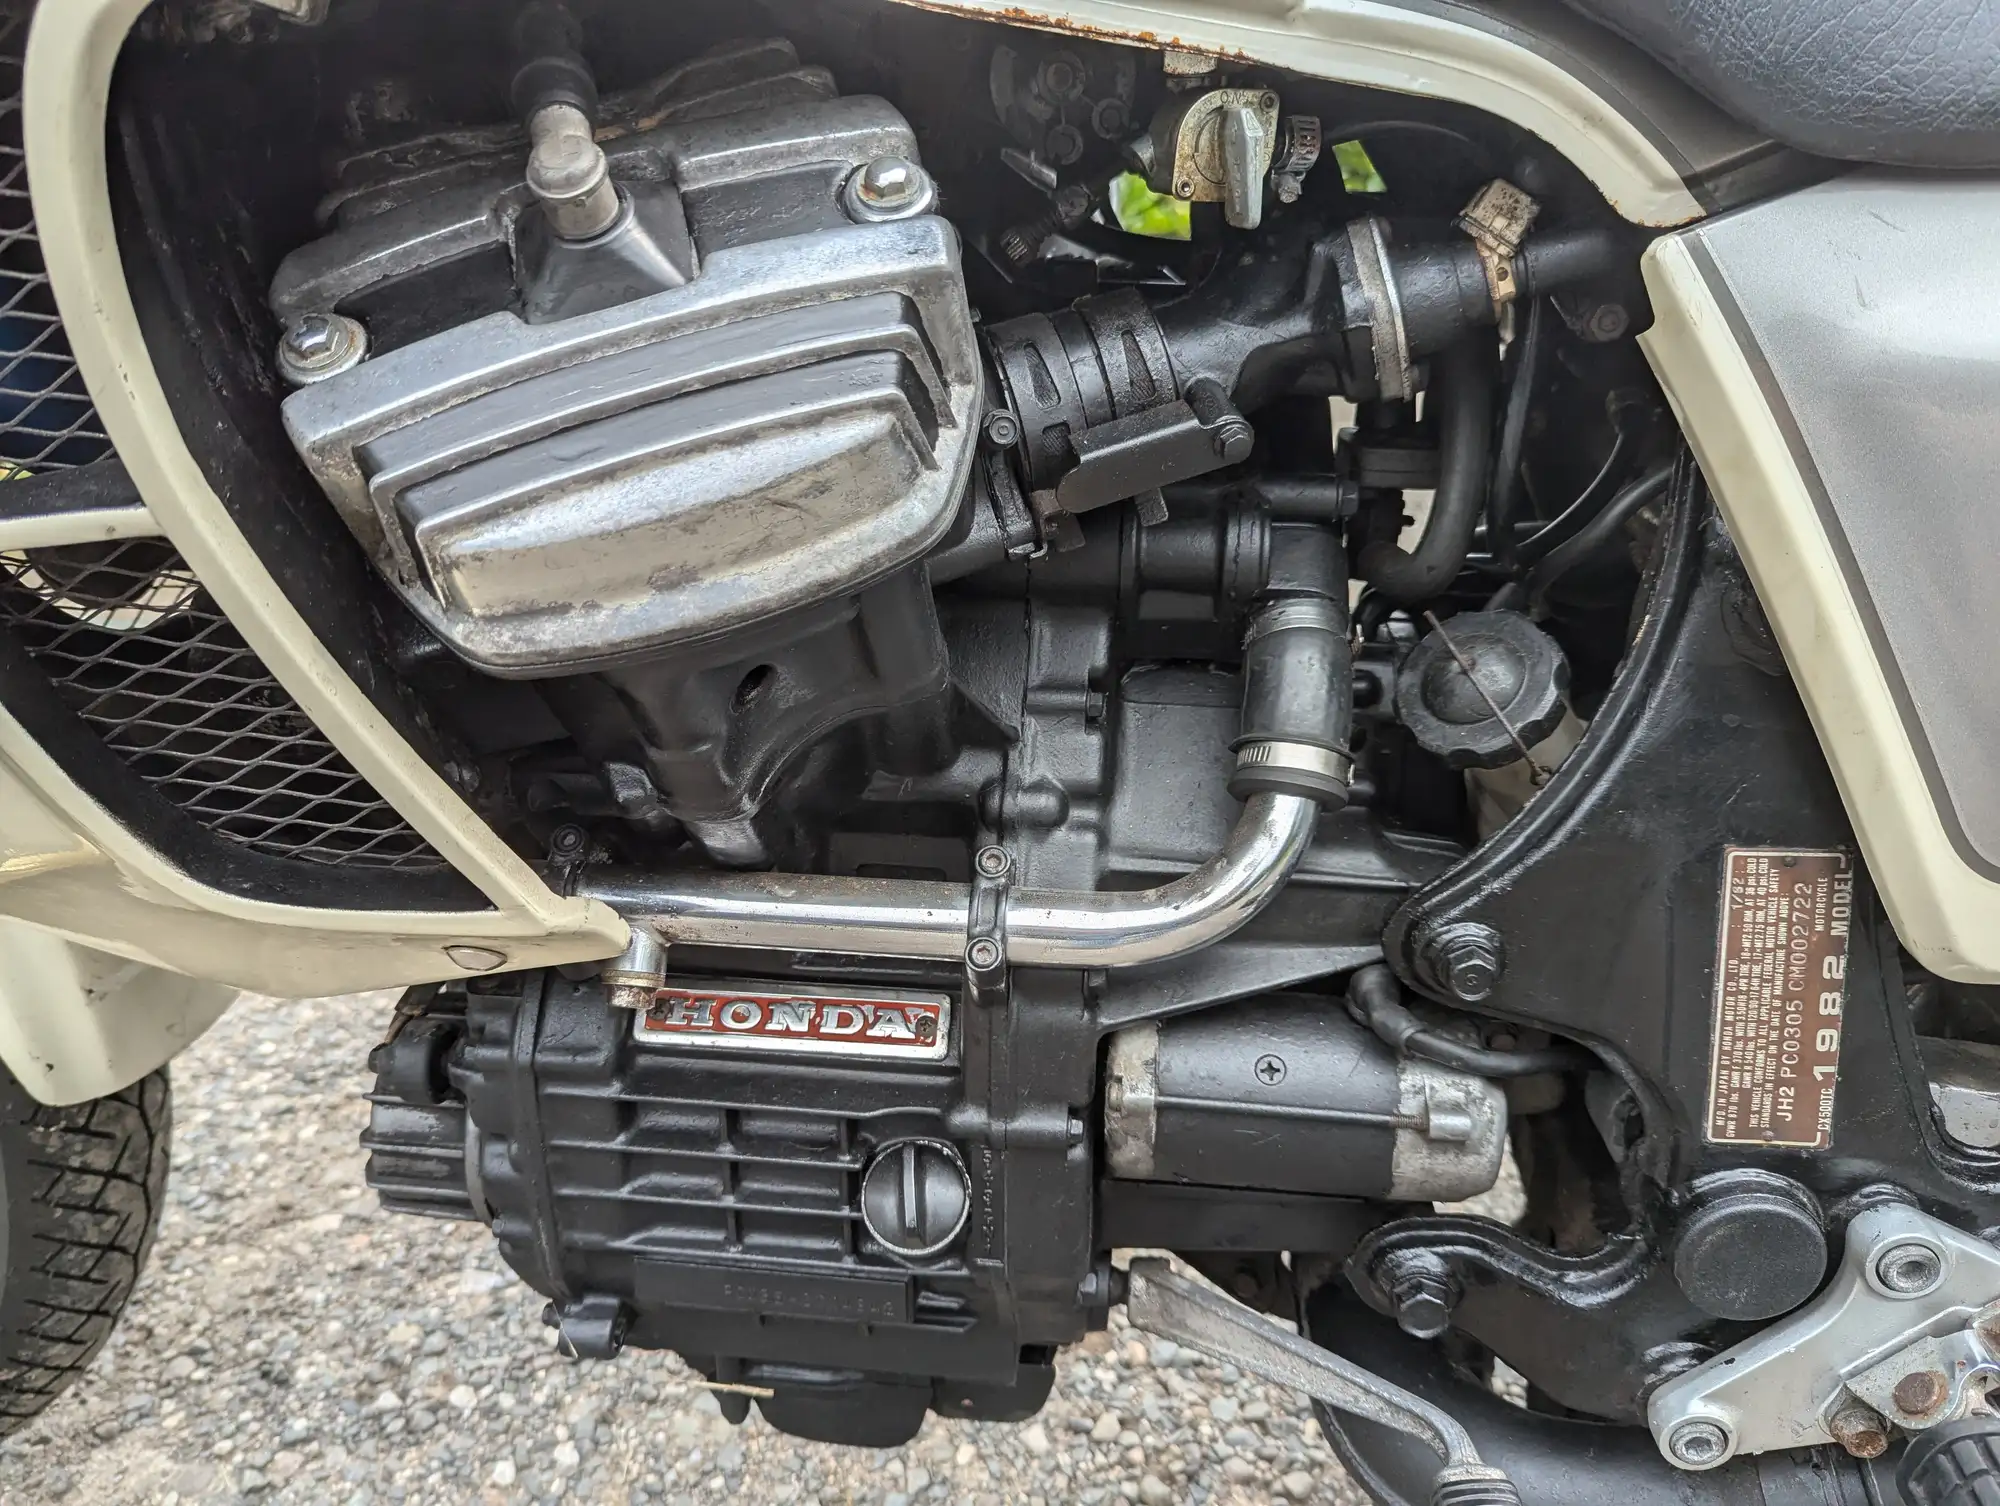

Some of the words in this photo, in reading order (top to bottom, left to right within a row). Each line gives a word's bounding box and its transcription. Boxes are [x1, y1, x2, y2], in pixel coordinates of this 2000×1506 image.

[1748, 858, 1757, 873] COLD
[1760, 858, 1770, 873] COLD
[1758, 887, 1767, 895] 40
[1769, 869, 1780, 892] SAFETY
[1731, 878, 1744, 909] 1/82
[1814, 877, 1828, 931] MOTORCYCLE
[1767, 896, 1777, 922] VEHICLE
[1765, 926, 1775, 948] MOTOR
[1776, 922, 1787, 944] SHOWN
[1788, 882, 1812, 991] CM002722
[1729, 957, 1738, 972] LTD.
[1763, 952, 1773, 978] FEDERAL
[1772, 949, 1785, 994] MANUFACTURE
[1813, 954, 1844, 1082] 1982
[1831, 869, 1852, 936] MODEL
[1724, 996, 1735, 1021] MOTOR
[1758, 982, 1771, 1020] APPLICABLE
[665, 996, 917, 1039] HONDA
[1769, 1011, 1780, 1026] DATE
[1722, 1026, 1732, 1050] HONDA
[1735, 1022, 1744, 1036] WITH
[1746, 1022, 1757, 1036] WITH
[1757, 1024, 1767, 1035] ALL
[1768, 1030, 1779, 1040] THE
[1780, 999, 1803, 1078] PC0305
[1733, 1051, 1742, 1062] 370
[1744, 1051, 1754, 1063] 540
[1767, 1045, 1777, 1053] ON
[1721, 1056, 1730, 1064] BY
[1754, 1049, 1765, 1083] CONFORMS
[1765, 1058, 1776, 1079] EFFECT
[1718, 1070, 1729, 1093] JAPAN
[1731, 1071, 1740, 1087] GAWR
[1742, 1072, 1753, 1088] GAWR
[1717, 1098, 1727, 1106] IN
[1751, 1087, 1763, 1110] VEHICLE
[1776, 1086, 1794, 1121] JH2
[1817, 1088, 1832, 1130] CX500TC
[1716, 1109, 1726, 1125] MFD.
[1728, 1106, 1738, 1118] 870
[1750, 1114, 1760, 1127] THIS
[1761, 1093, 1774, 1127] STANDARDS
[1727, 1121, 1737, 1137] GVWR
